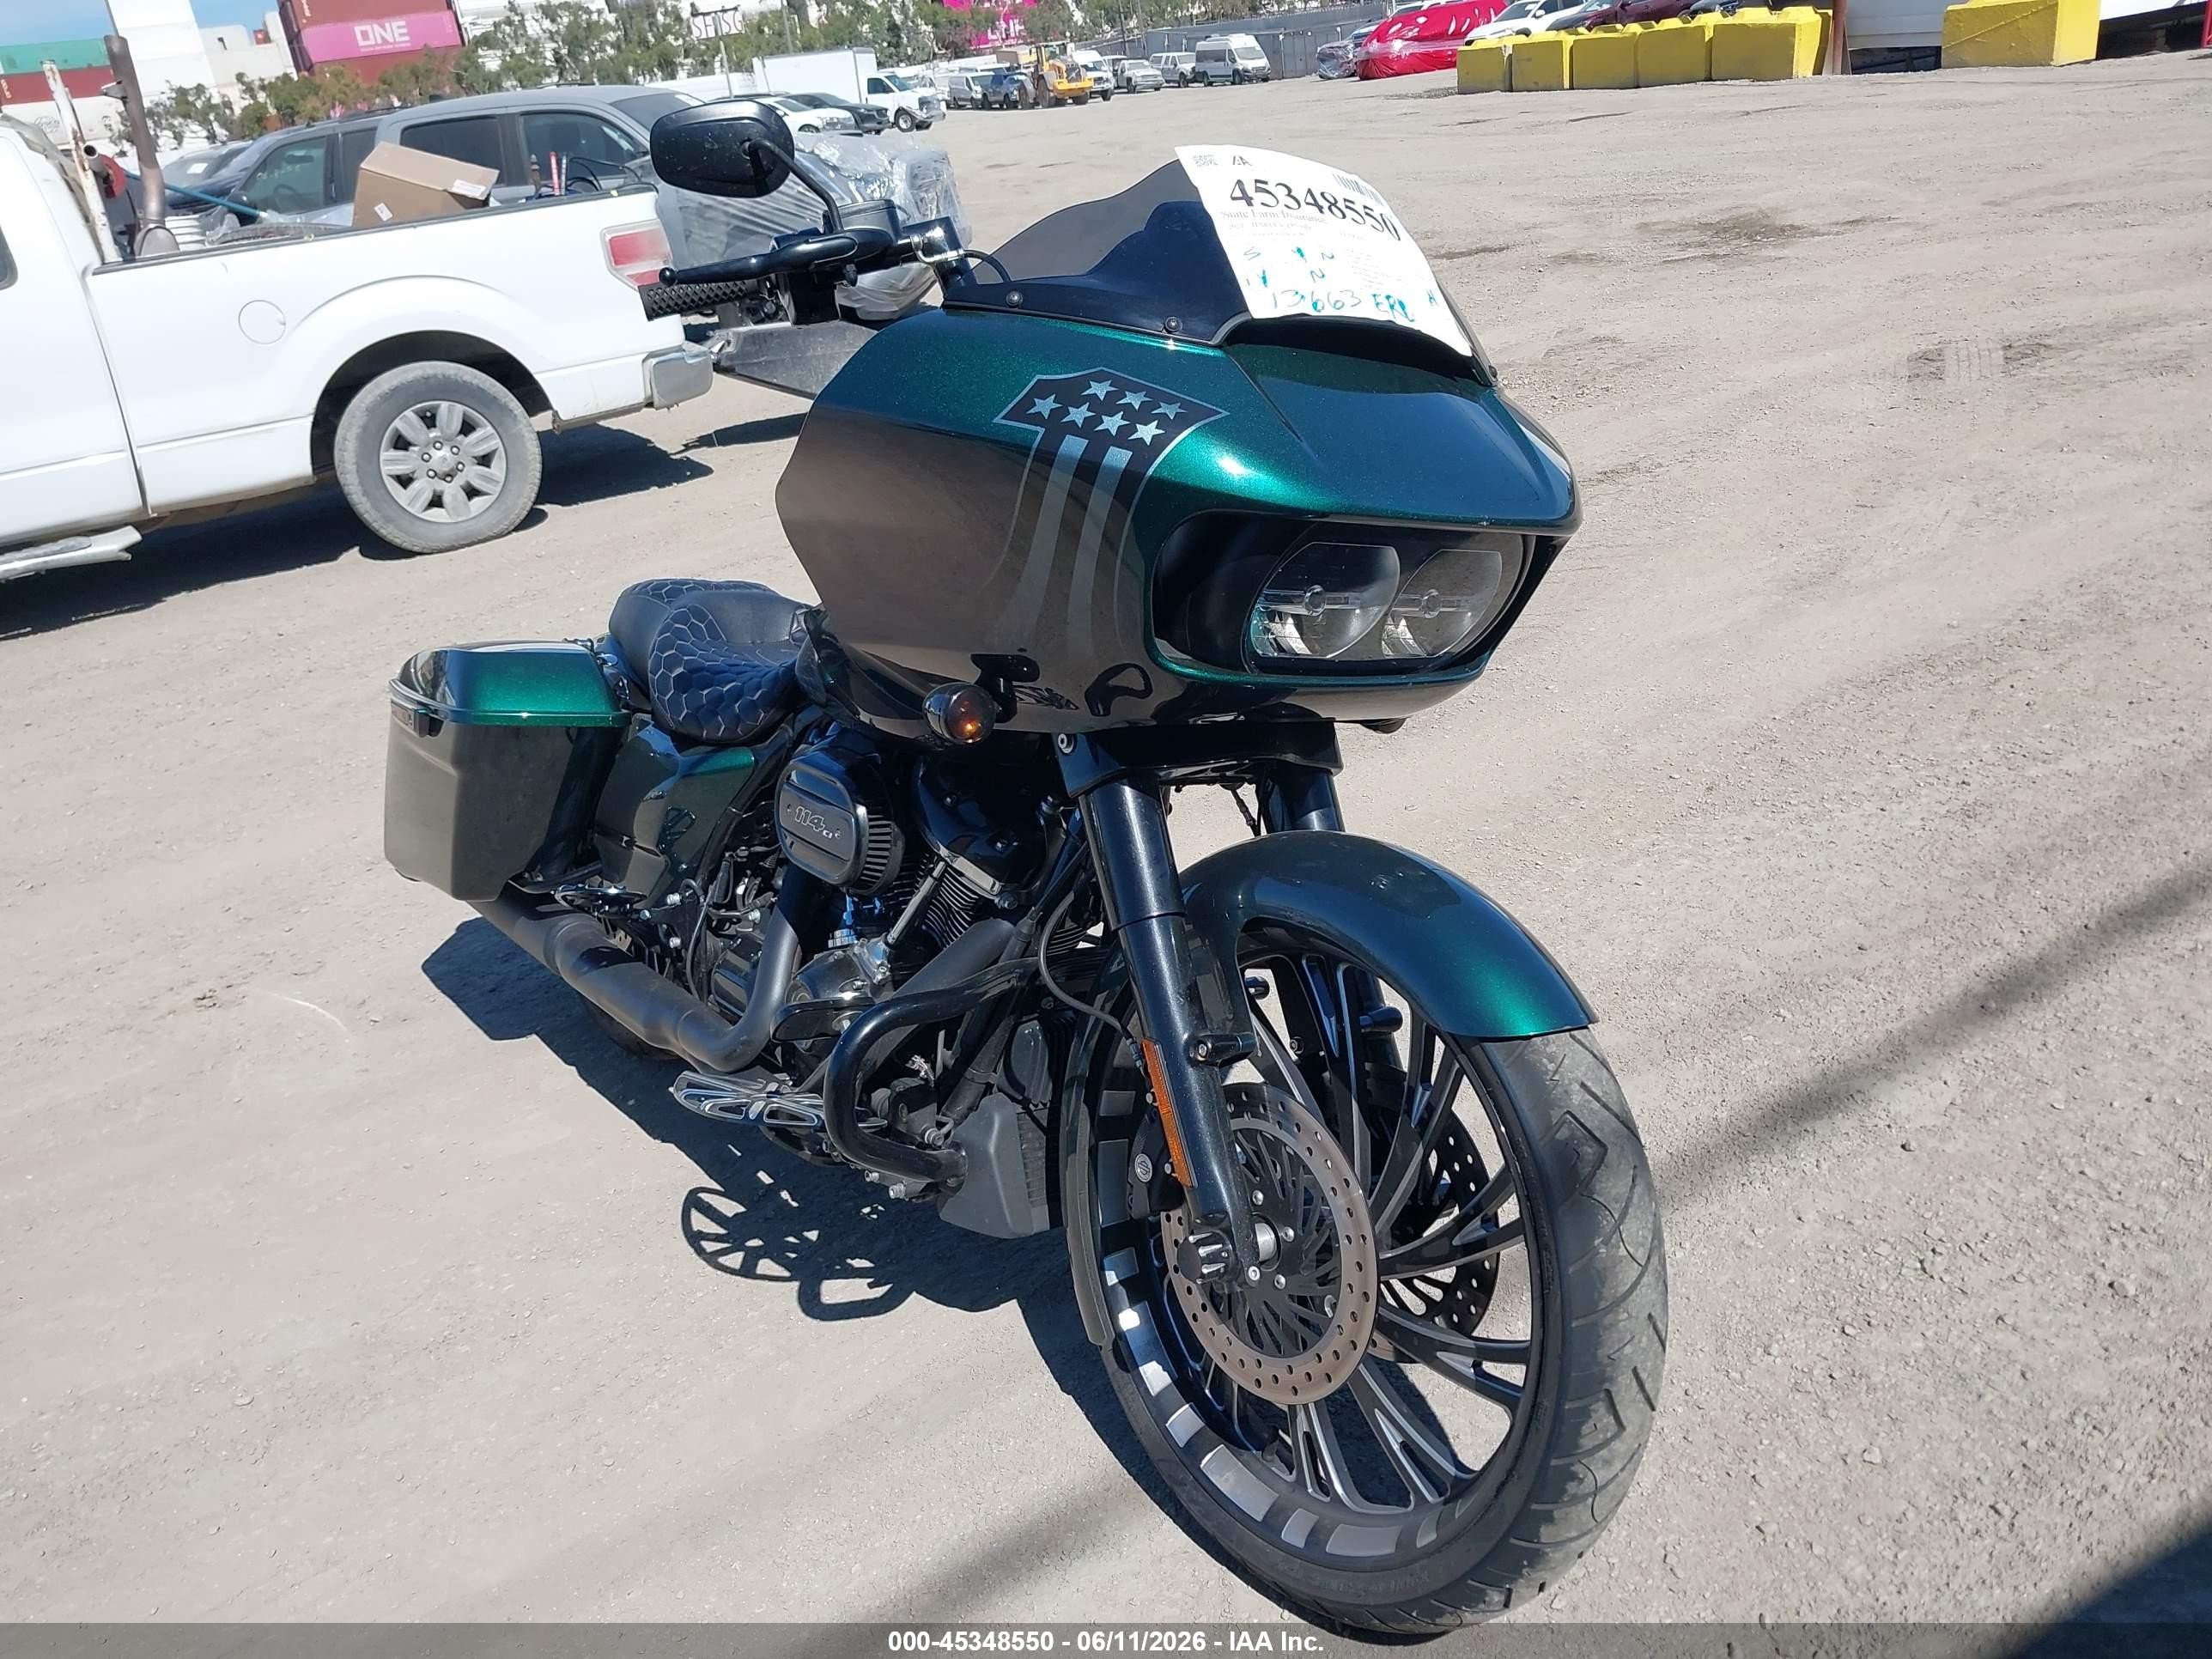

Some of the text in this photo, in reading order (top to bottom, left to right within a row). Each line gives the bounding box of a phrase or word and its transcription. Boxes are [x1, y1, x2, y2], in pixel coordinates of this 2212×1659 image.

[354, 21, 410, 46] ONE
[1231, 179, 1401, 241] 45348550
[795, 806, 825, 832] 114
